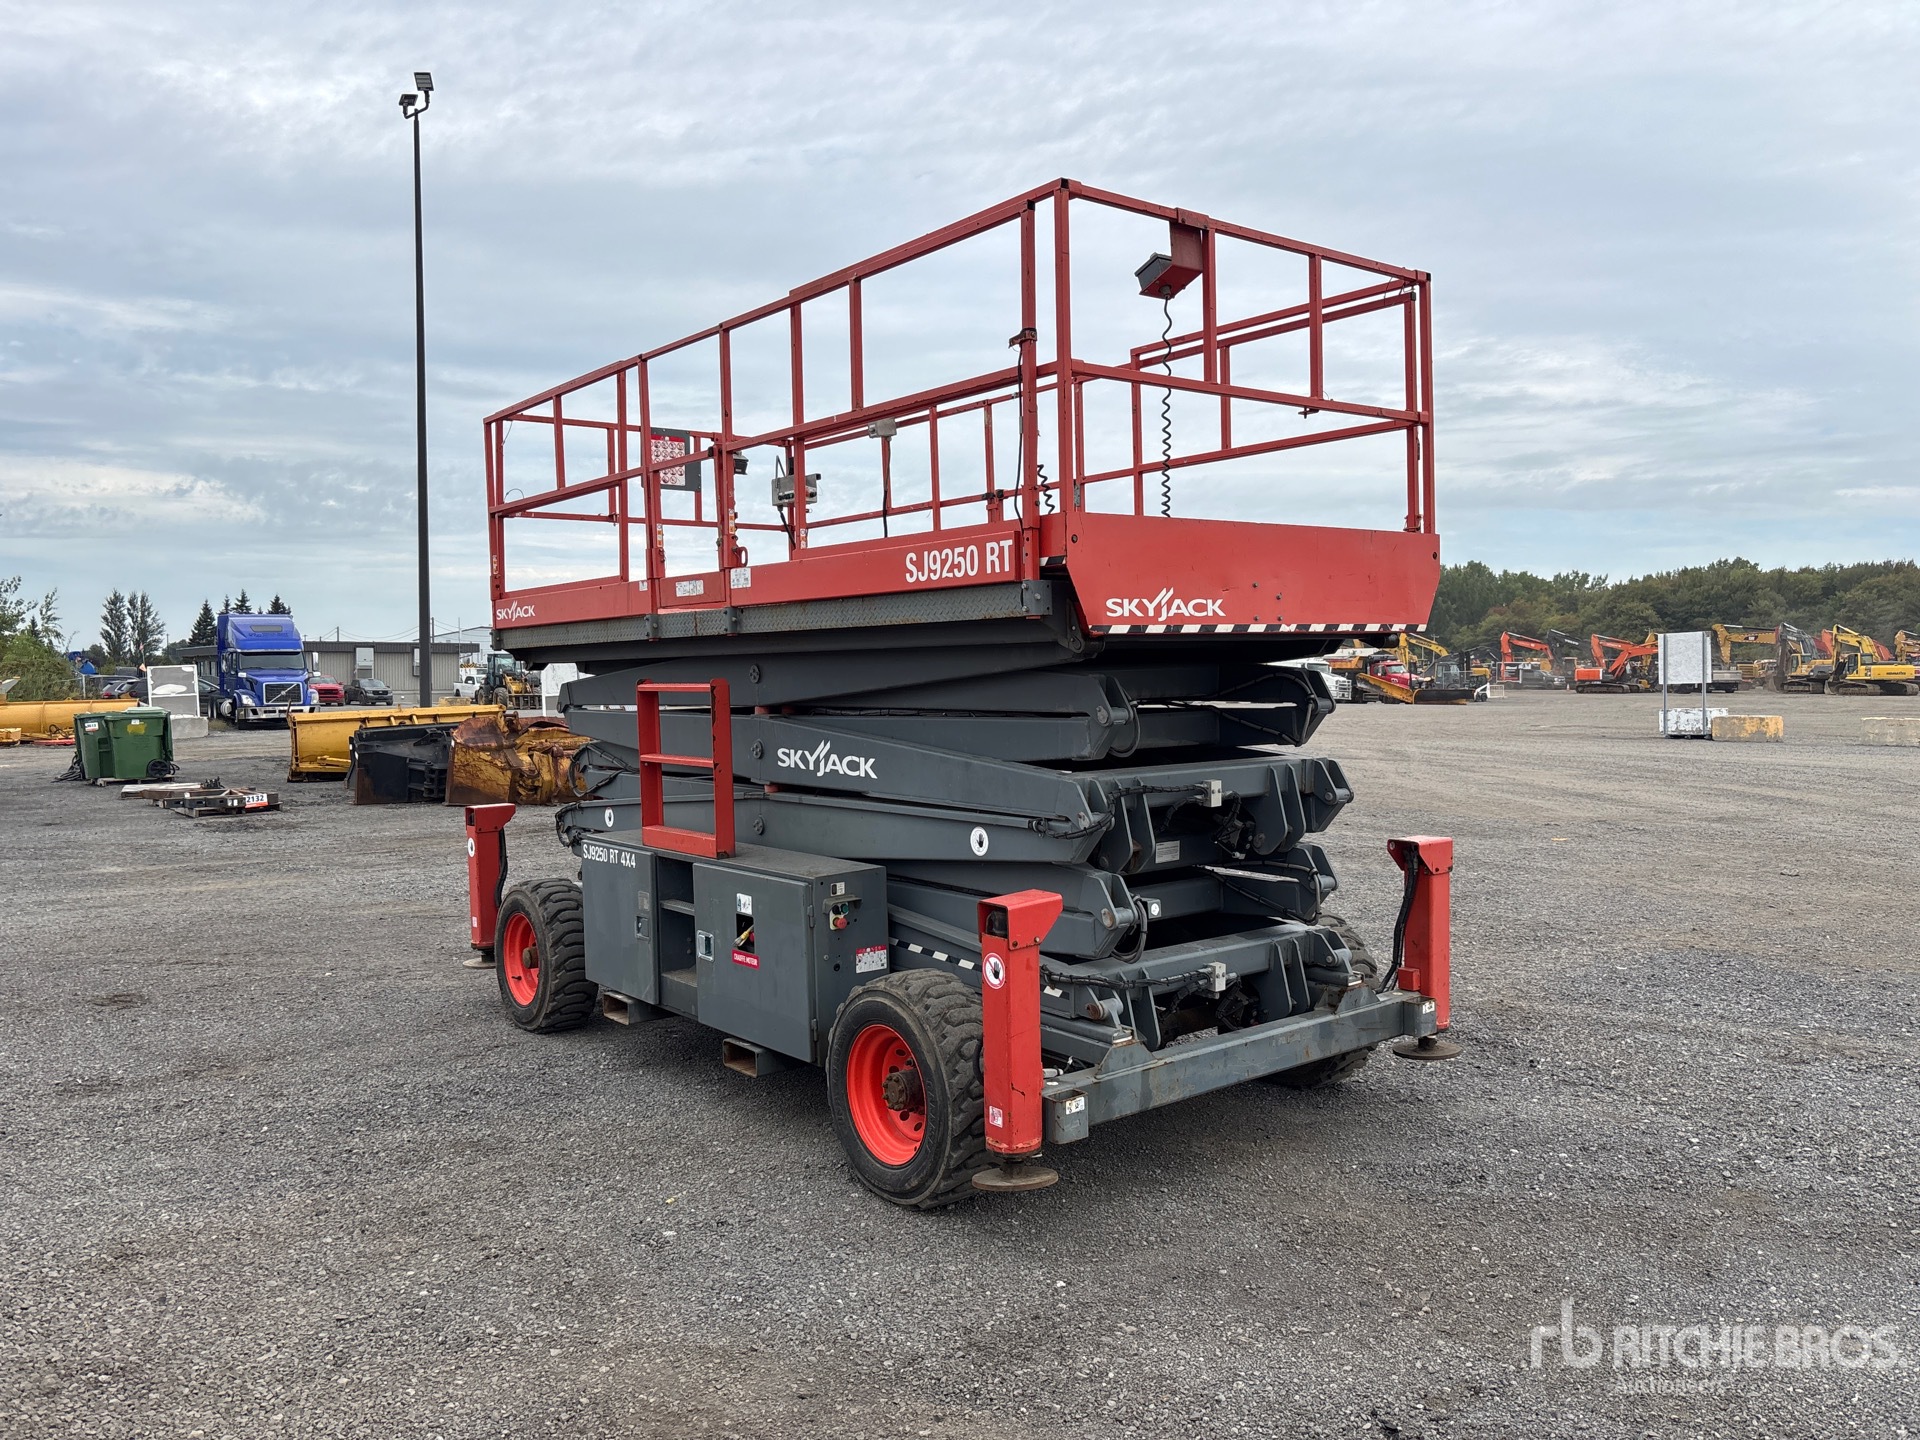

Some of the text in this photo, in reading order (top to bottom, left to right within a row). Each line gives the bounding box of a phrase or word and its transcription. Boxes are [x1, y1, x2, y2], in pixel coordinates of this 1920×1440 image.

[905, 539, 1013, 583] SJ9250 RT
[496, 600, 536, 622] SKYJACK
[1105, 586, 1227, 622] SKYJACK
[777, 739, 878, 779] SKYJACK
[583, 844, 636, 869] SJ9250 RT 4X4
